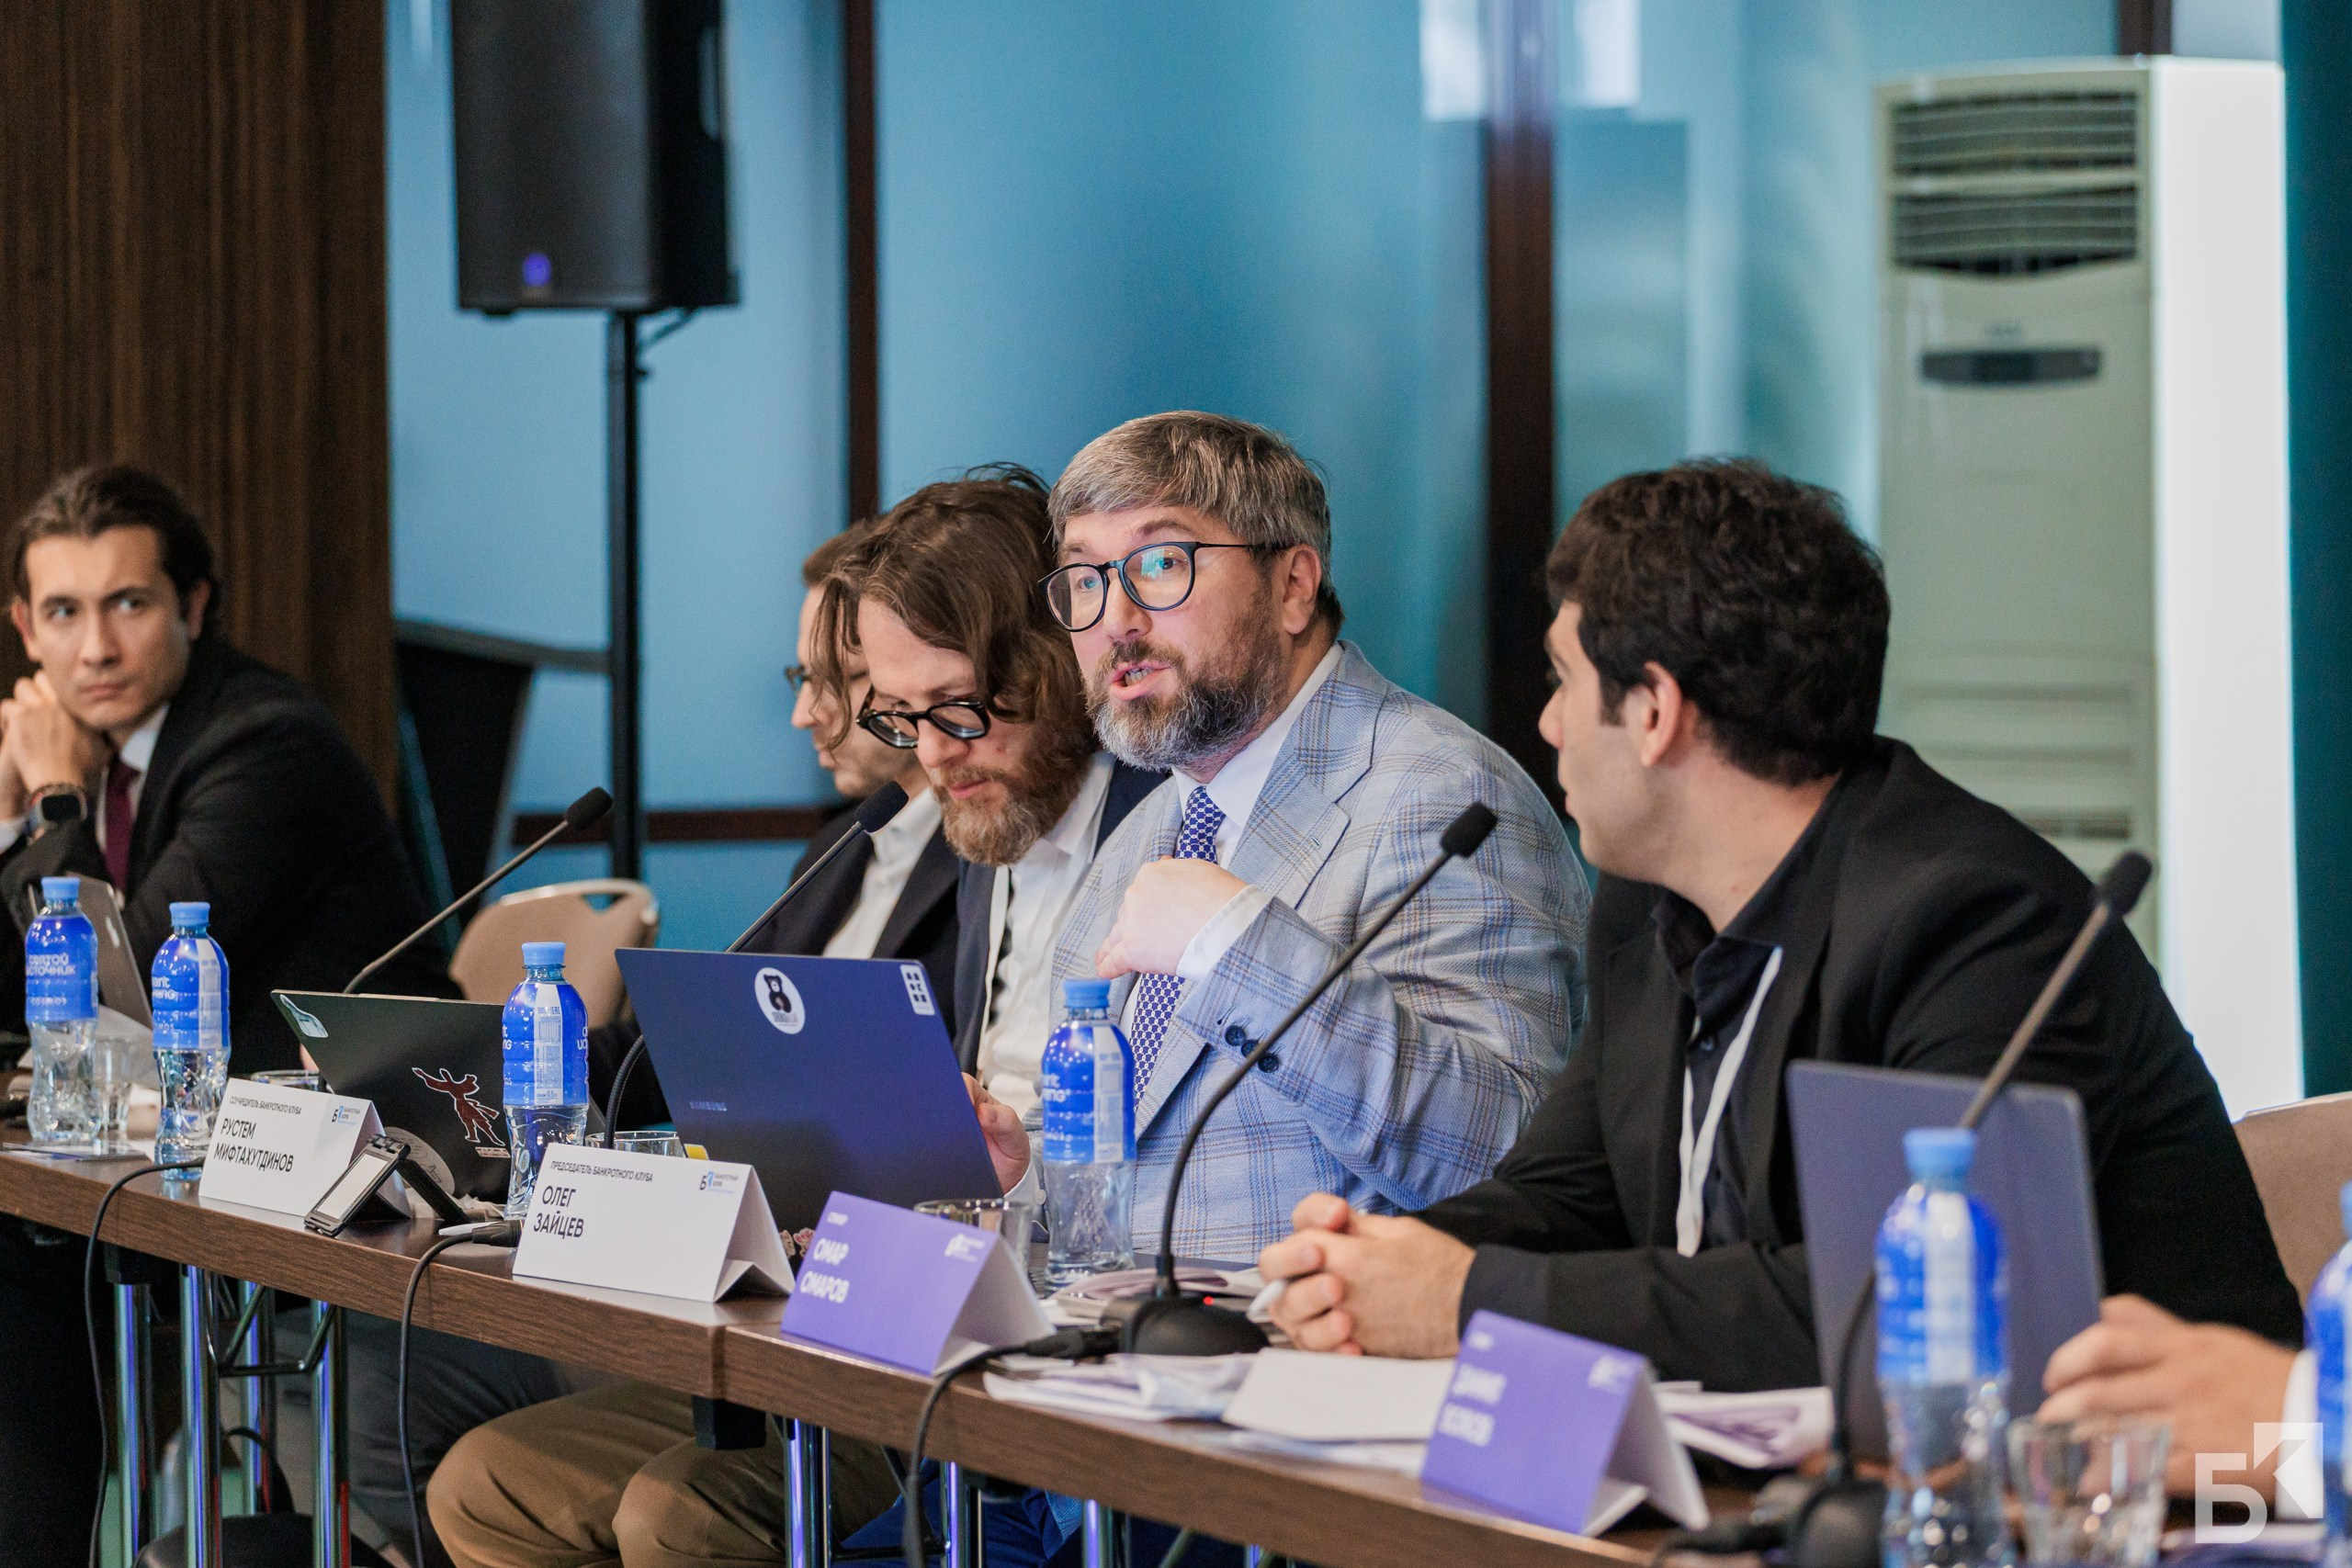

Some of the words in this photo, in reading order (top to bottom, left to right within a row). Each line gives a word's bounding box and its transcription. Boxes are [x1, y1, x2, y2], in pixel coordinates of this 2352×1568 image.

[259, 1100, 288, 1113] БАНКРОТНОГО
[288, 1104, 301, 1115] КЛУБА
[220, 1118, 256, 1139] РУСТЕМ
[214, 1142, 294, 1172] МИФТАХУТДИНОВ
[550, 1160, 592, 1174] ПРЕДСЕДАТЕЛЬ
[593, 1166, 634, 1179] БАНКРОТНОГО
[634, 1172, 653, 1182] КЛУБА
[542, 1185, 577, 1207] ОЛЕГ
[533, 1210, 584, 1240] ЗАЙЦЕВ
